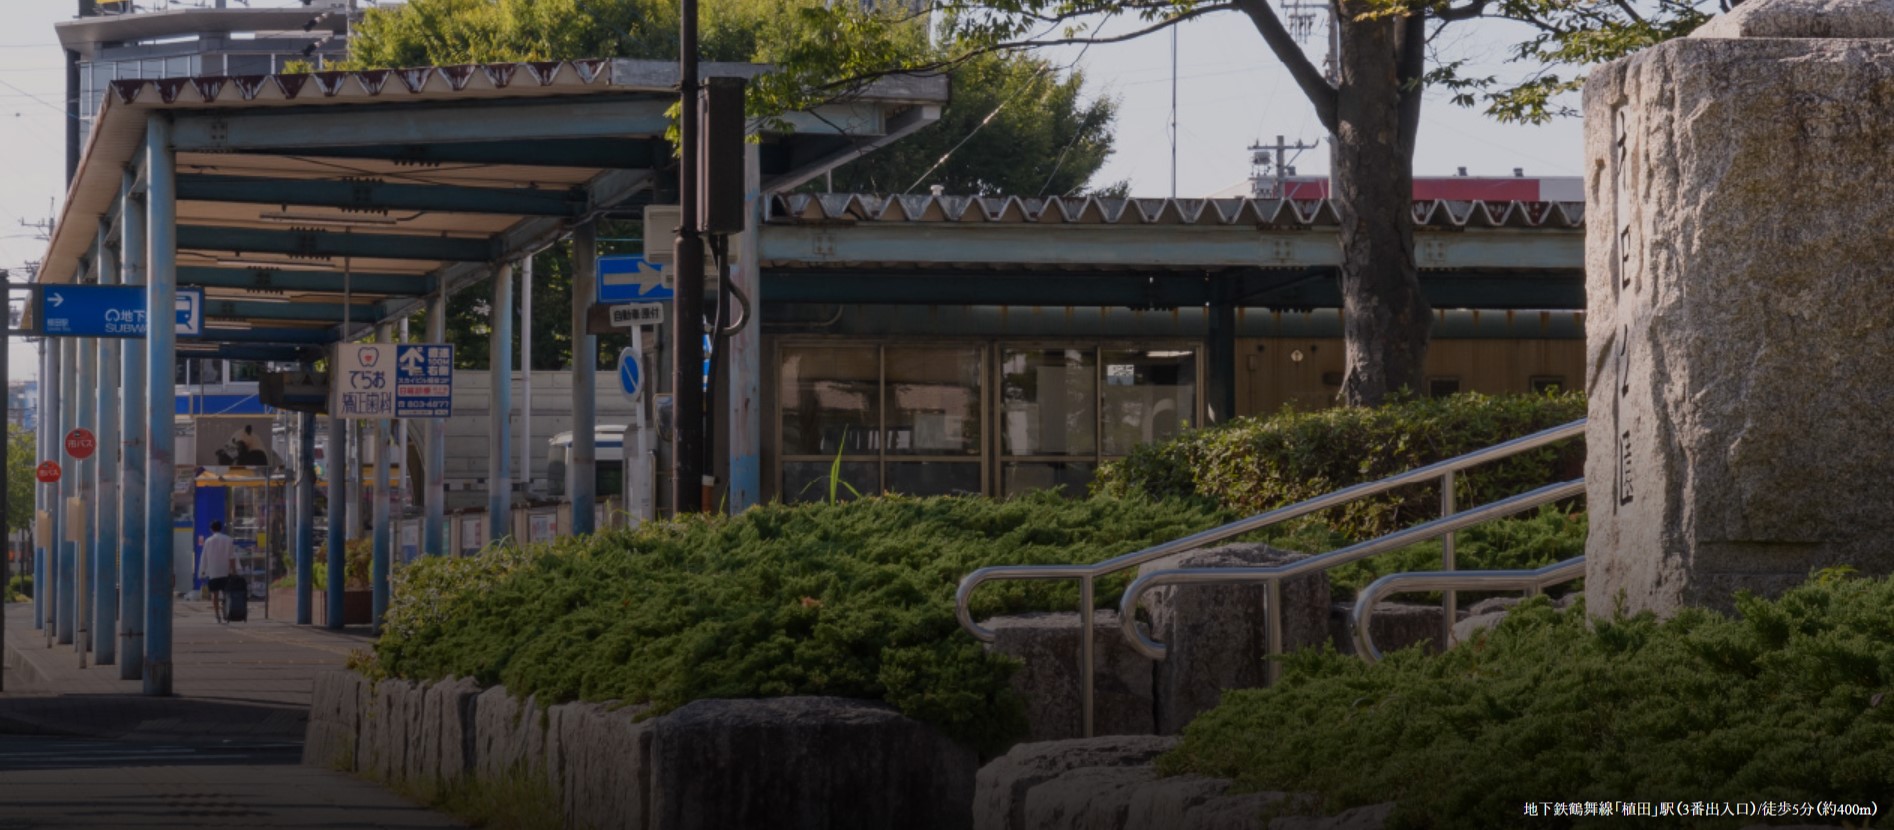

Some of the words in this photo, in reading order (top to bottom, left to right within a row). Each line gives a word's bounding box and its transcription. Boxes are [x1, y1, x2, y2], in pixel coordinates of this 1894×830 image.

[348, 370, 386, 390] てらお
[341, 391, 392, 414] 矯正歯科
[67, 439, 94, 449] 市バス
